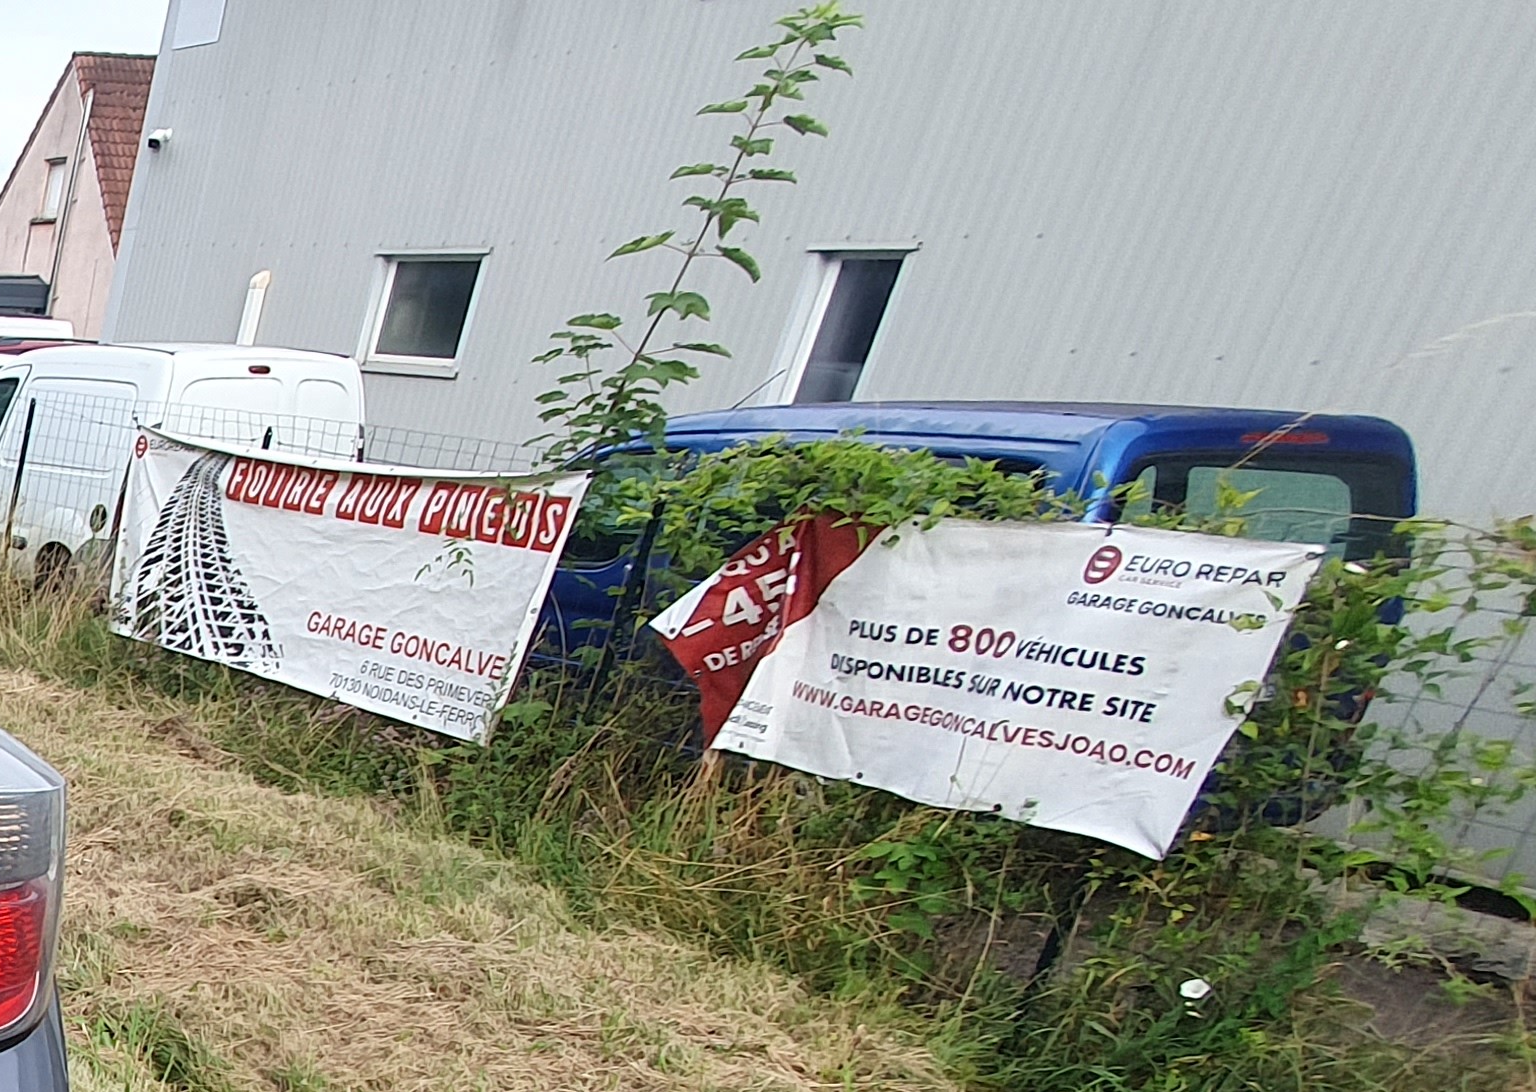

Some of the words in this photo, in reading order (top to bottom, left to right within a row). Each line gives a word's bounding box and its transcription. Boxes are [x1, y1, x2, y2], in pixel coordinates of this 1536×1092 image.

[228, 462, 334, 509] FOIRE
[339, 479, 416, 522] AUX
[424, 488, 564, 545] PNEUS
[1124, 555, 1191, 578] EURO
[1194, 564, 1286, 588] REPAR
[1067, 591, 1138, 613] GARAGE
[306, 611, 388, 650] GARAGE
[849, 620, 898, 643] PLUS
[905, 627, 940, 646] DE
[948, 624, 1016, 659] 800
[1015, 636, 1146, 676] VÉHICULES
[360, 660, 368, 675] 6
[368, 662, 395, 682] RUE
[396, 669, 425, 689] DES
[702, 646, 739, 672] DE
[329, 672, 361, 694] 70130
[831, 653, 966, 689] DISPONIBLES
[967, 674, 1002, 697] SUR
[1002, 682, 1095, 712] NOTRE
[1102, 697, 1157, 723] SITE
[792, 680, 1197, 780] WWW.GARAGEGONCALVESJOAO.COM
